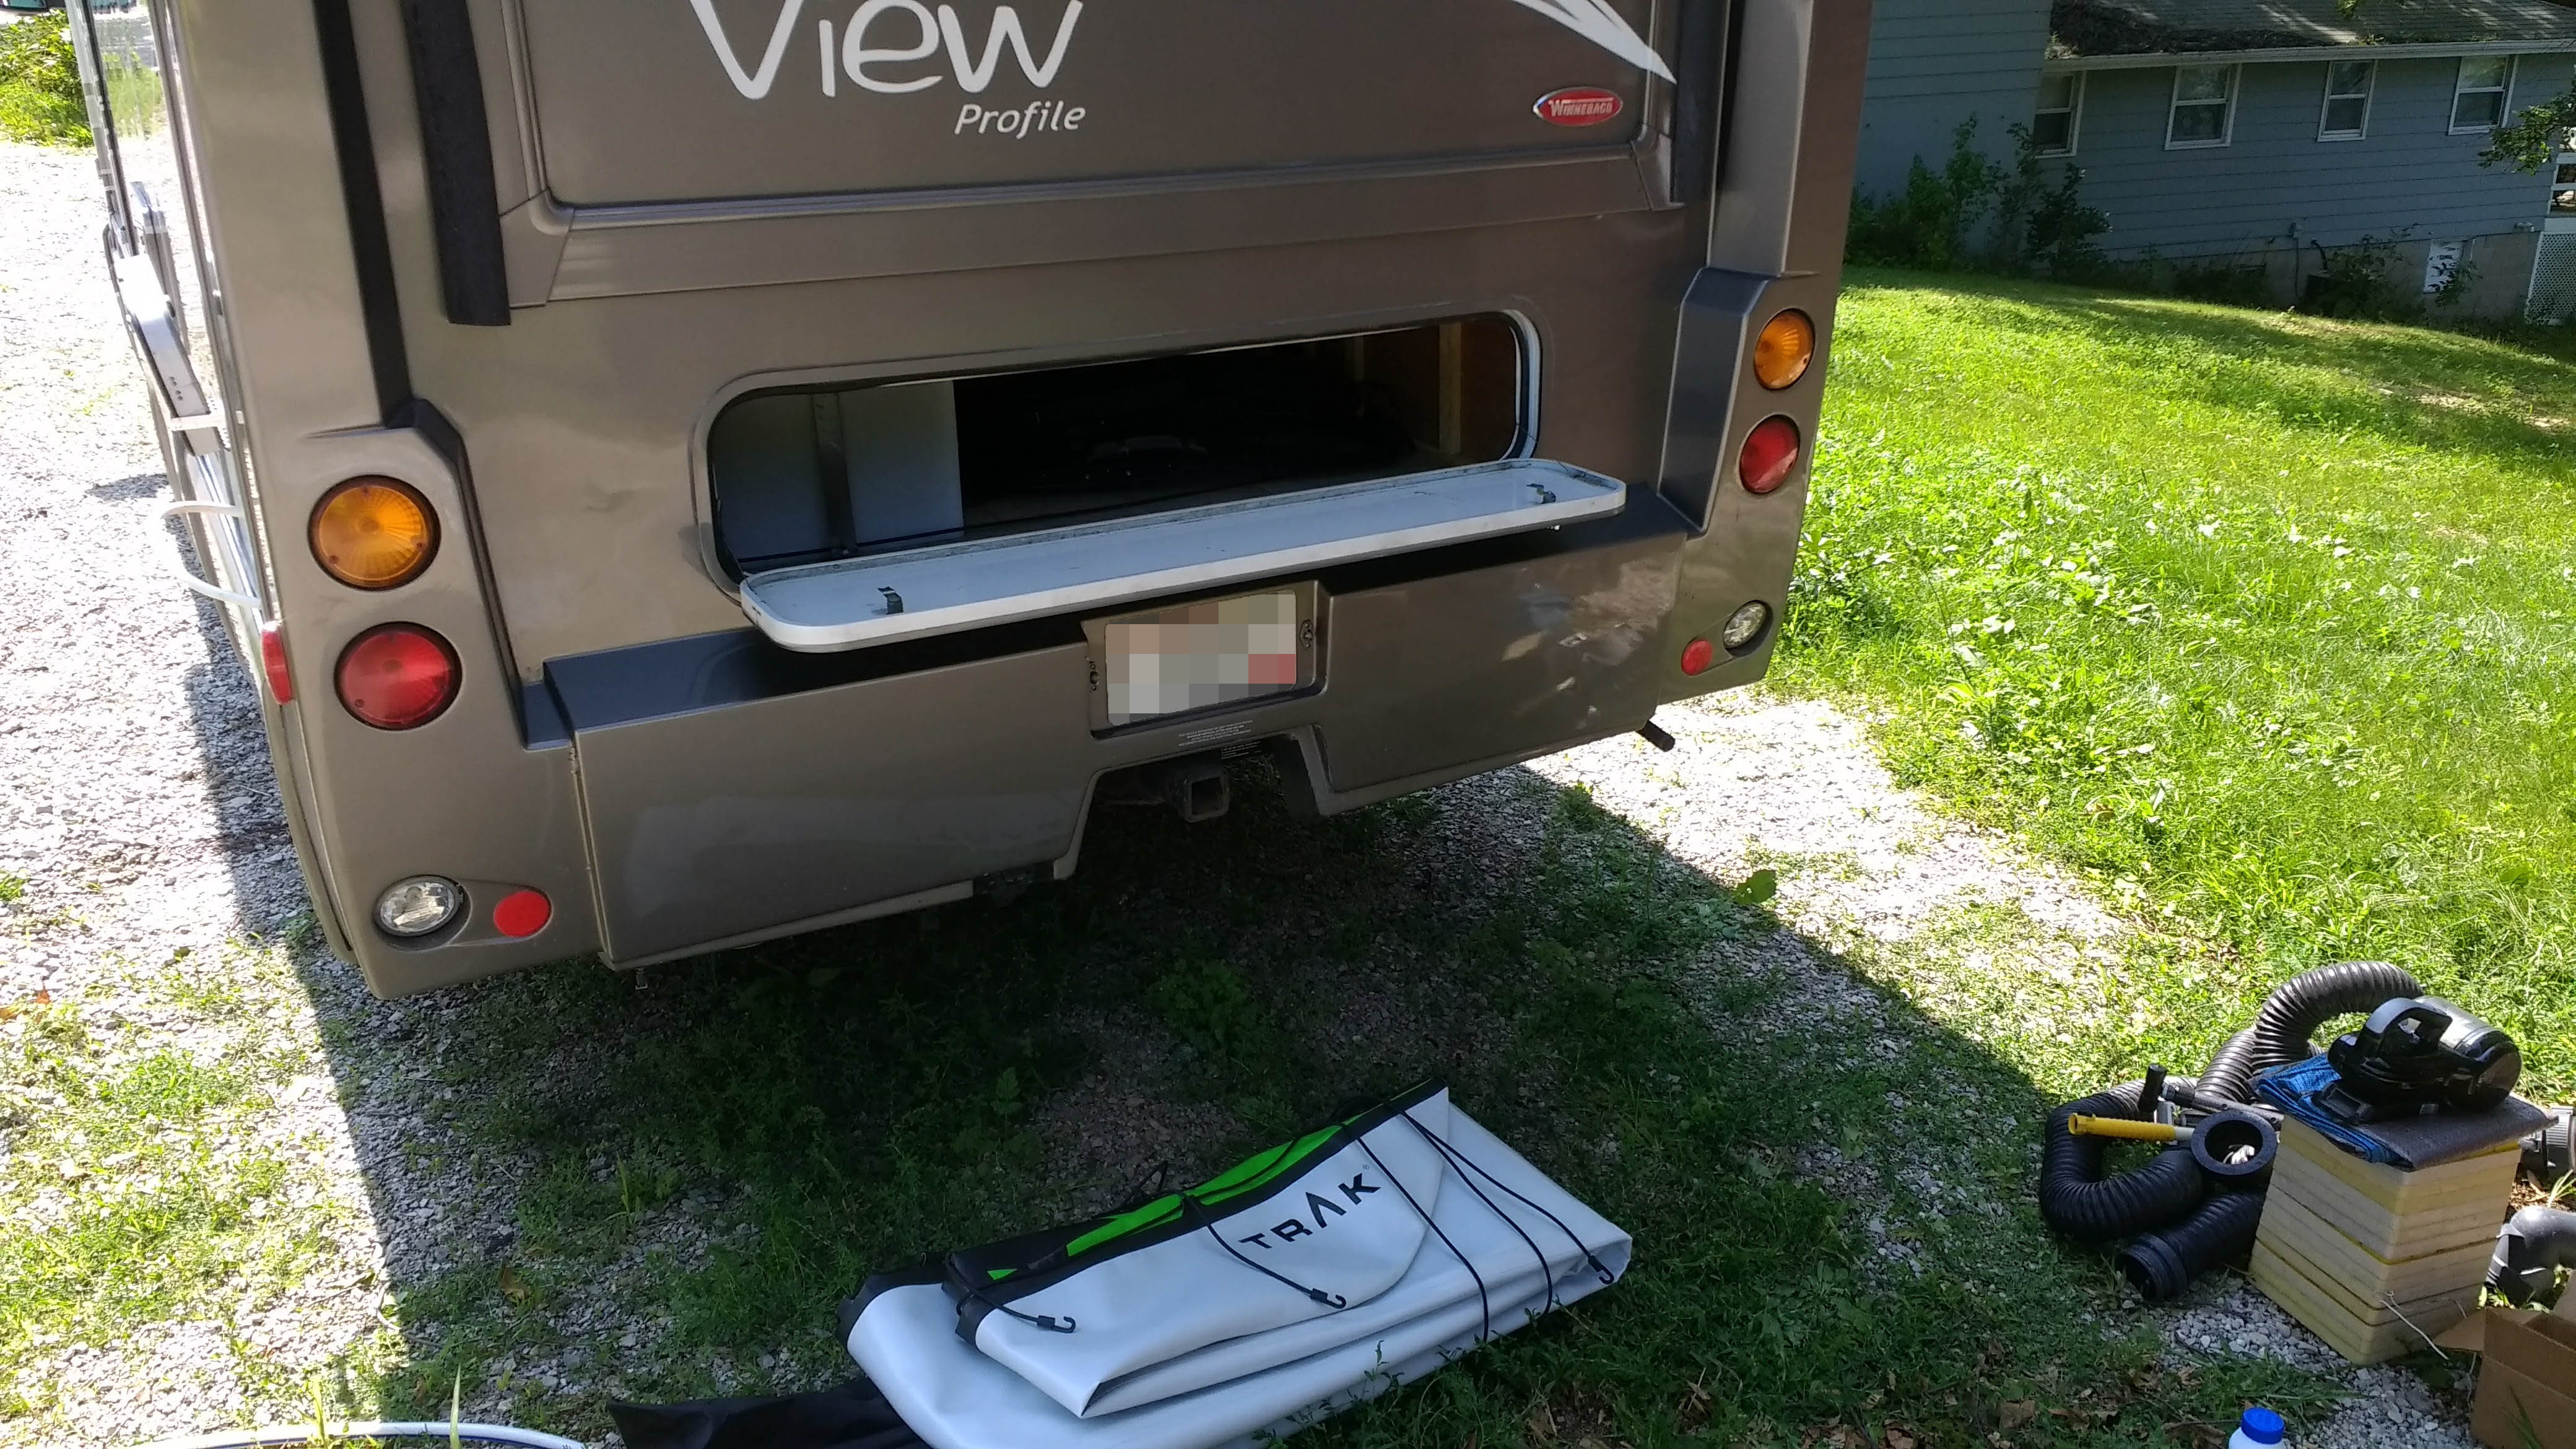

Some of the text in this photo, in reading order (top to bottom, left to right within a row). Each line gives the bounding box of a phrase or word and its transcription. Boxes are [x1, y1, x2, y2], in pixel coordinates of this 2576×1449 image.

[689, 0, 1083, 100] View
[954, 100, 1086, 139] Profile
[1238, 1173, 1382, 1249] TRAK
